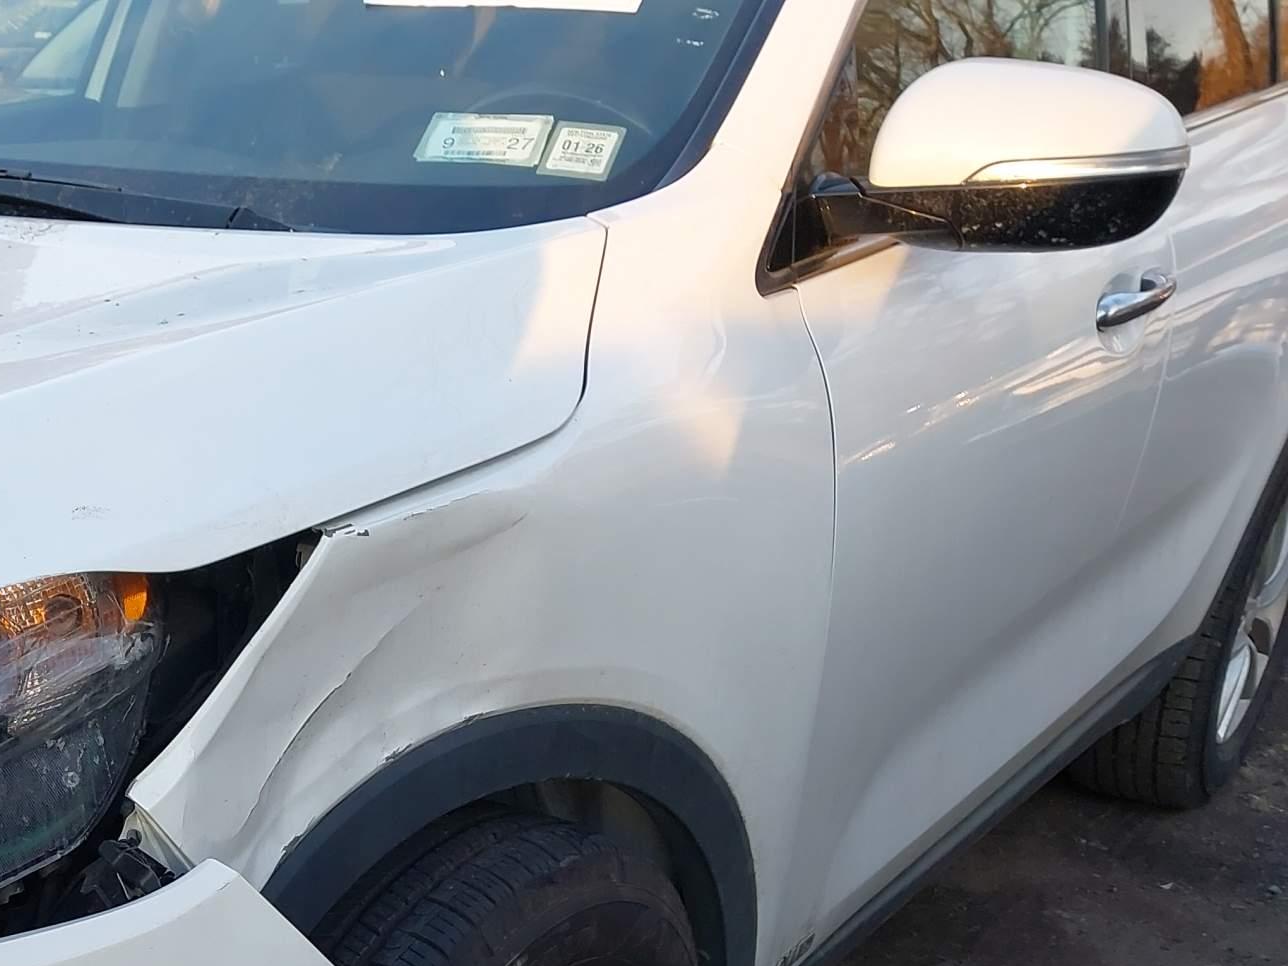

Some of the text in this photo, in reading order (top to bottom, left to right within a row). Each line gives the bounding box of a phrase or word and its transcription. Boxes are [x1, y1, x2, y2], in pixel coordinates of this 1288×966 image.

[441, 137, 454, 149] 9
[506, 137, 535, 150] 27
[561, 140, 605, 154] 01 26
